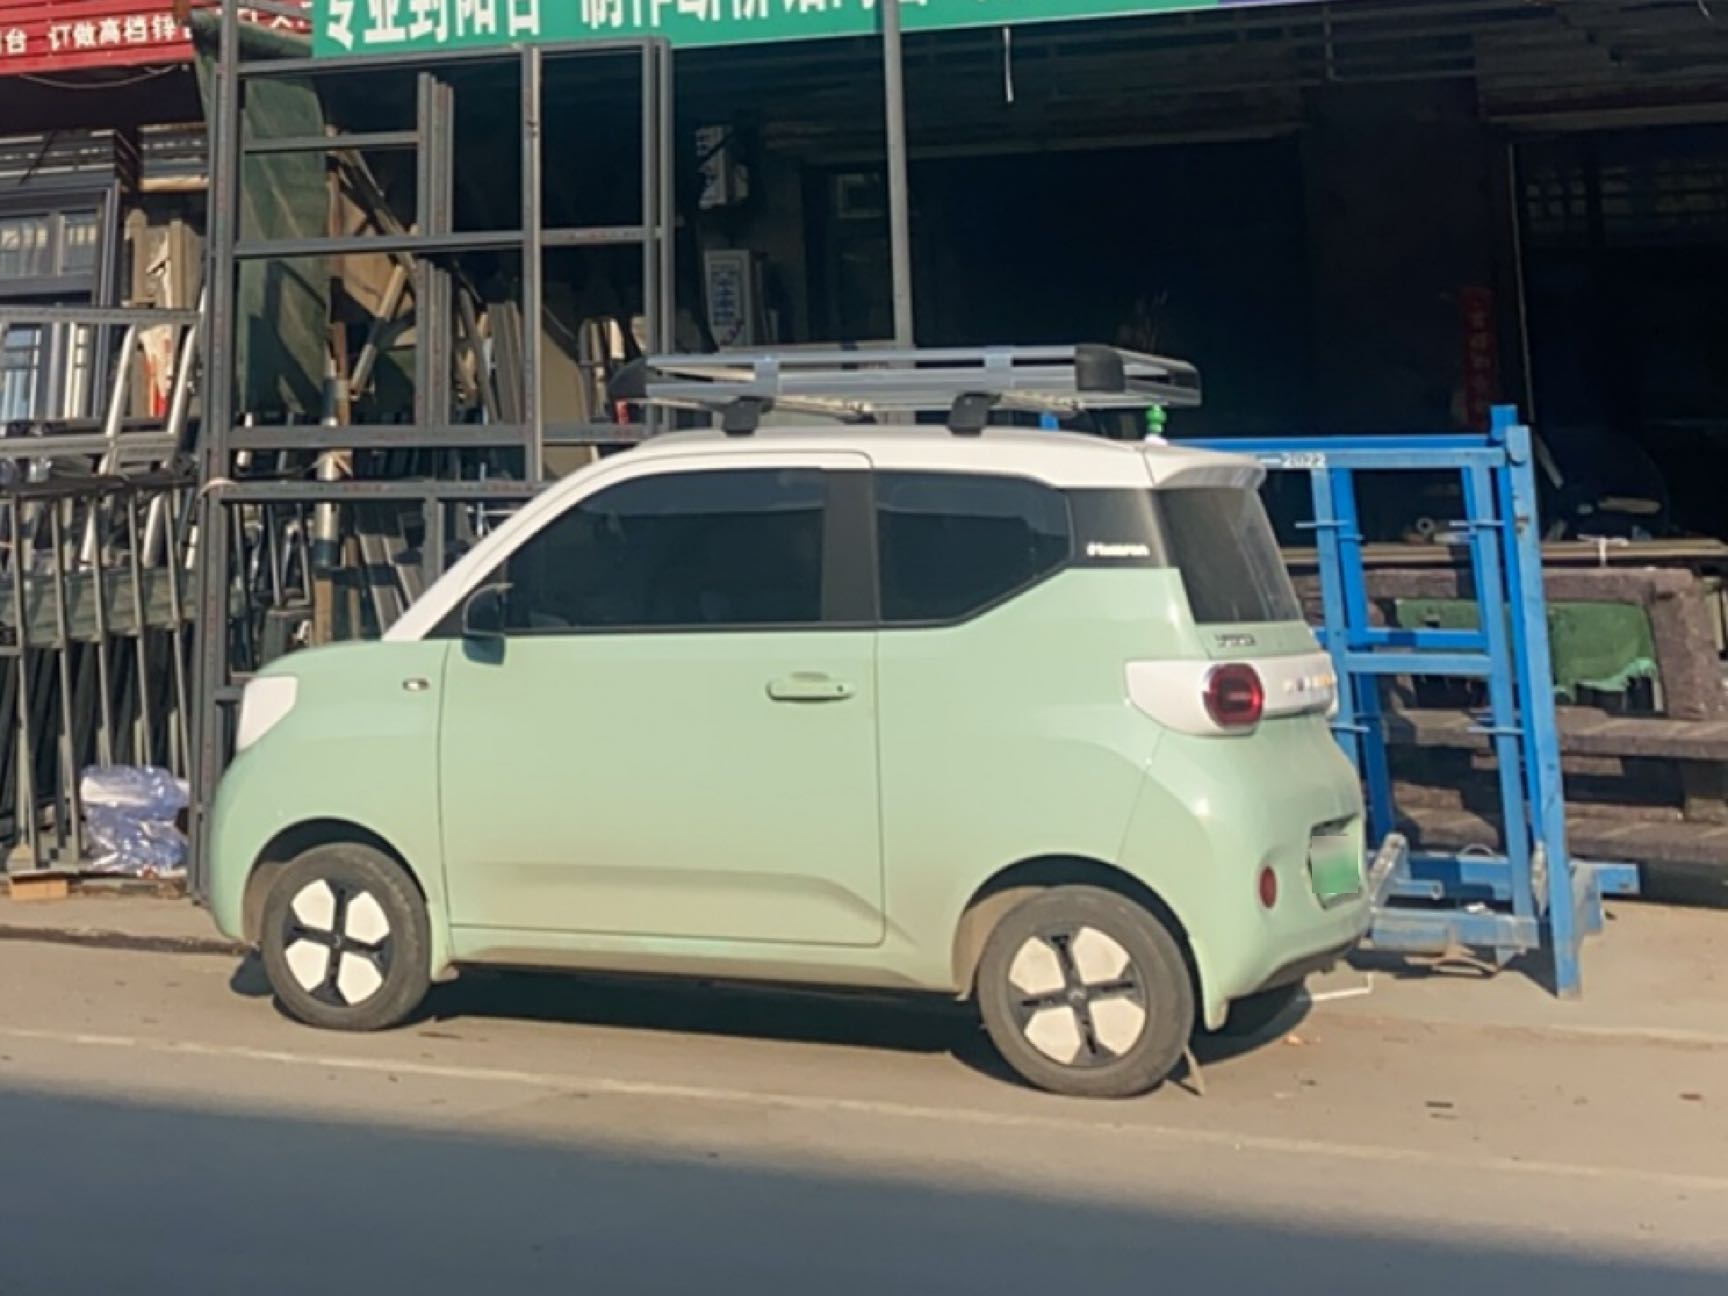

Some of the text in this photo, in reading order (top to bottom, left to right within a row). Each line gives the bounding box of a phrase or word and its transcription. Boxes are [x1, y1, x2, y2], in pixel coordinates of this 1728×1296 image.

[47, 12, 193, 52] 订做高档锌
